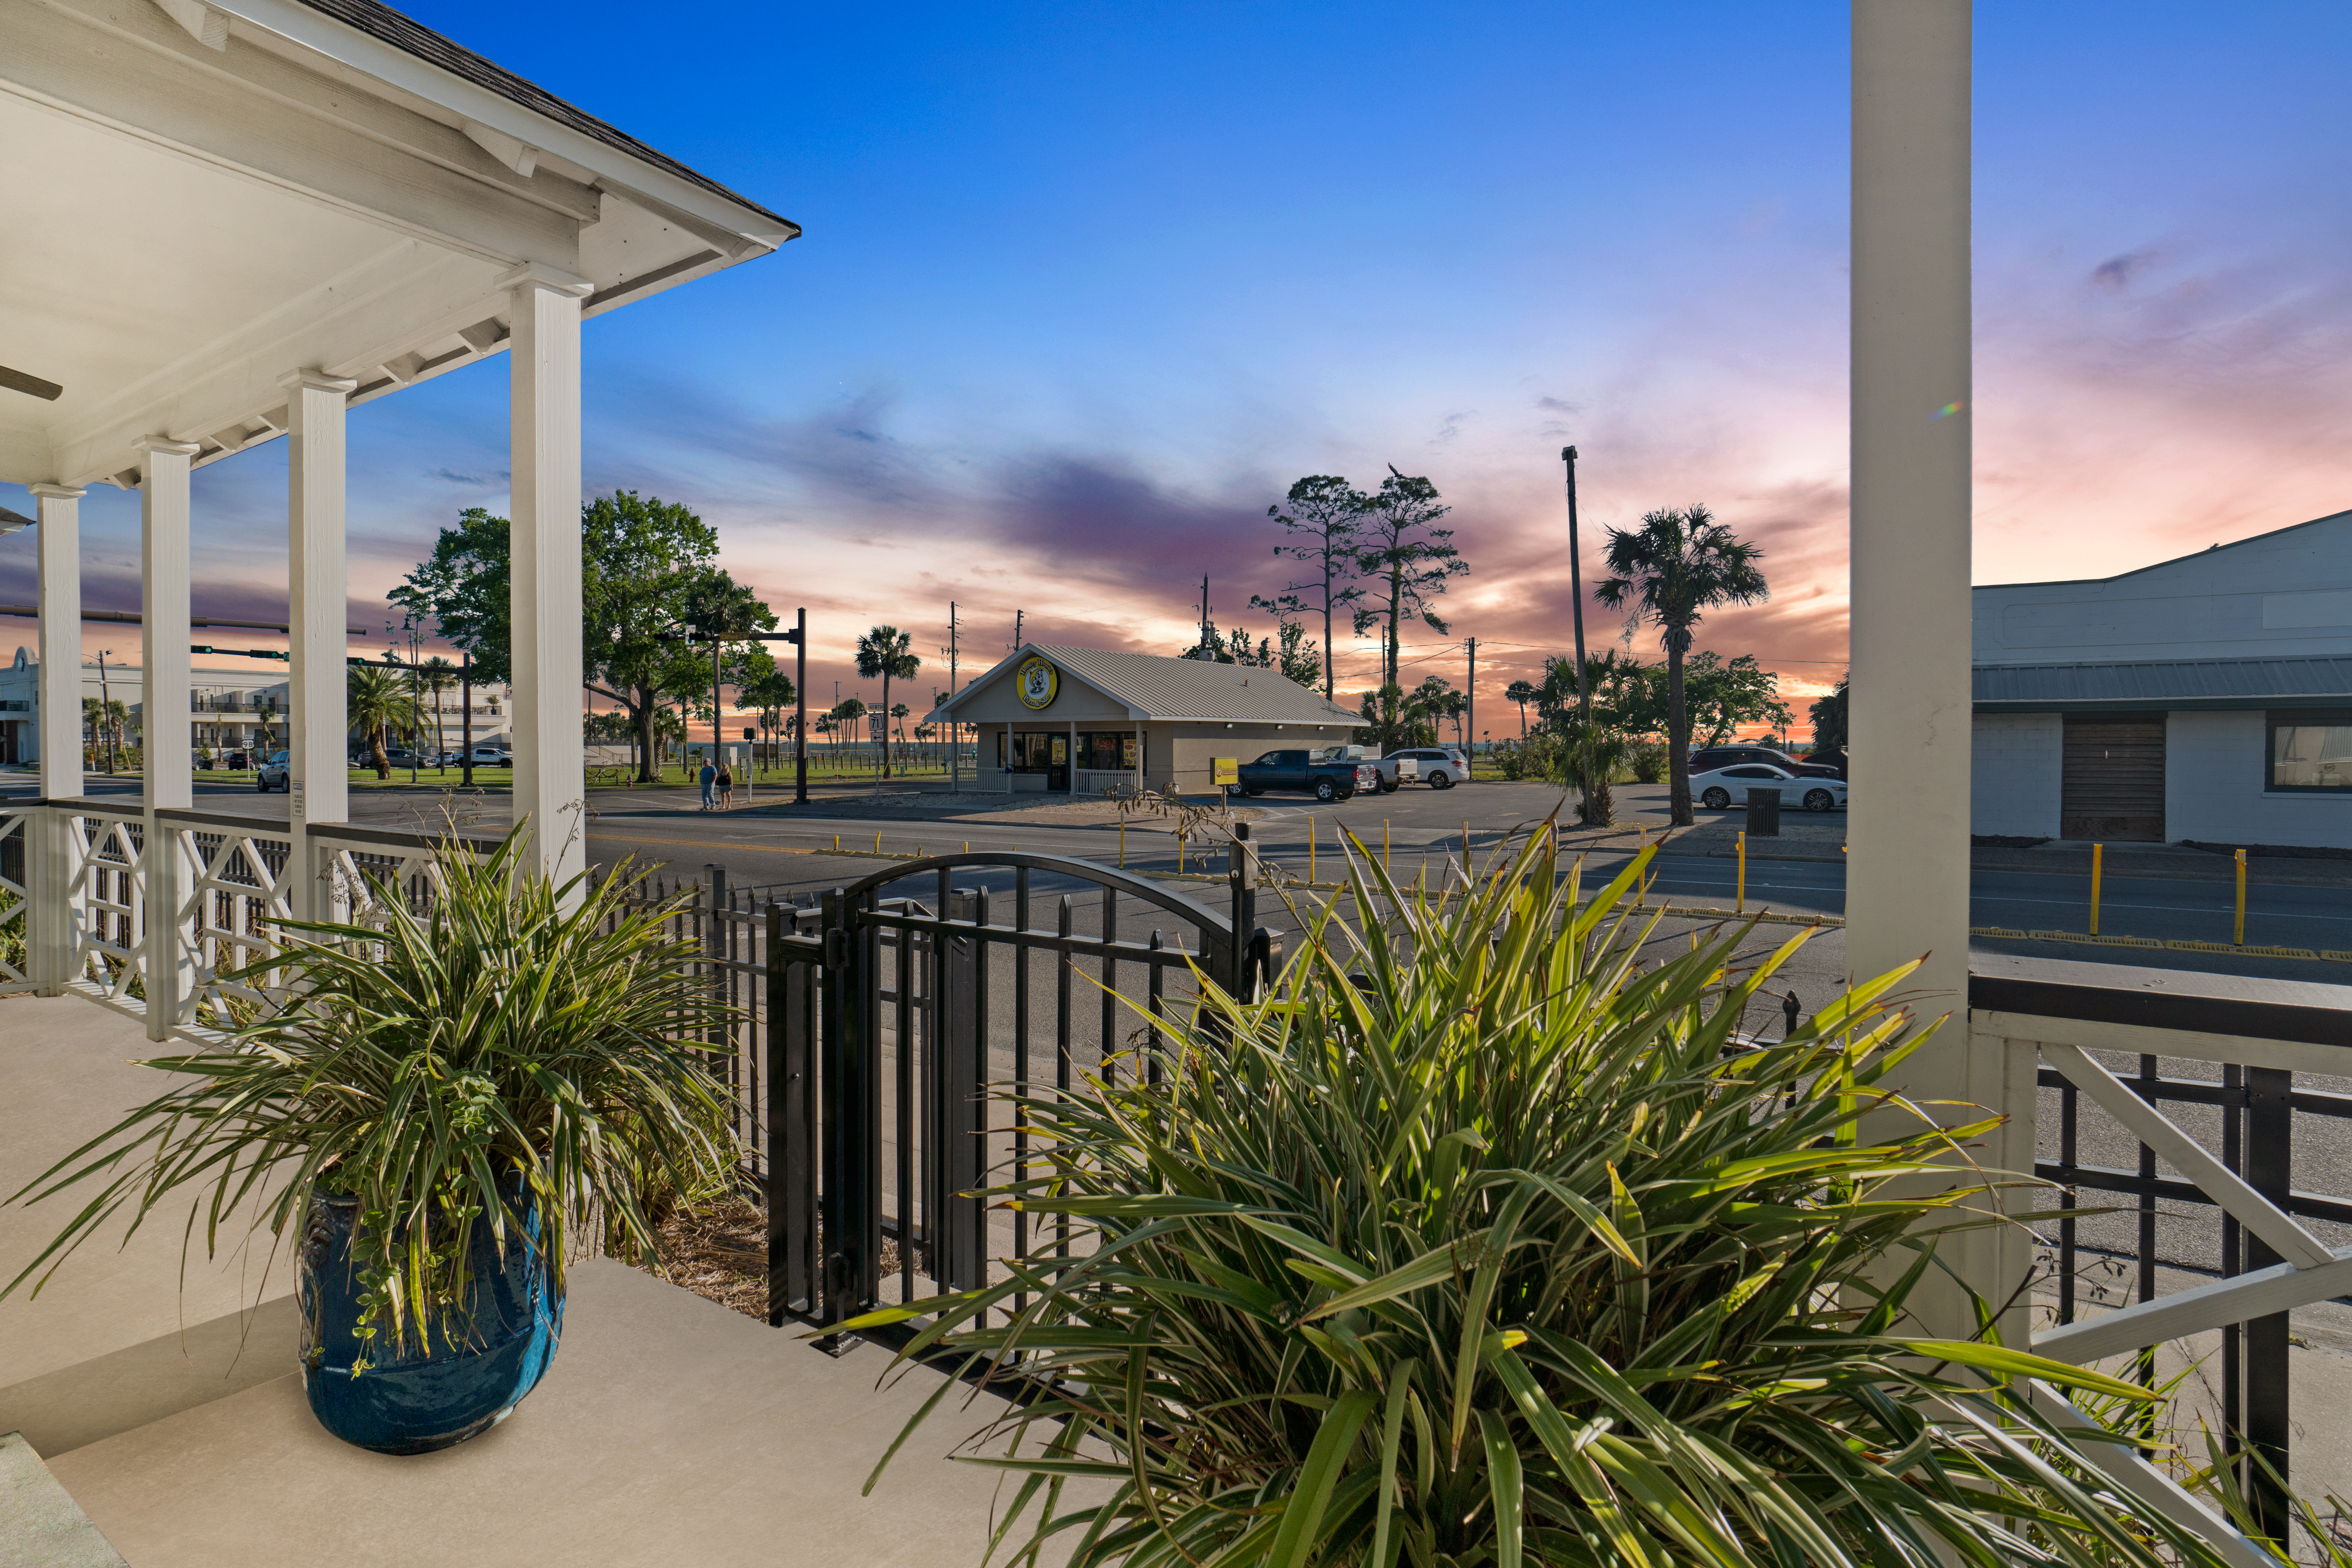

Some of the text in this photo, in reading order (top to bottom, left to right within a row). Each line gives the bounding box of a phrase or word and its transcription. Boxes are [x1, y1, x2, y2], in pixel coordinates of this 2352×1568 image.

[1020, 659, 1053, 676] Hungry Howie's
[1022, 694, 1035, 706] Pizza
[1040, 694, 1051, 706] Subs
[871, 719, 878, 728] 71
